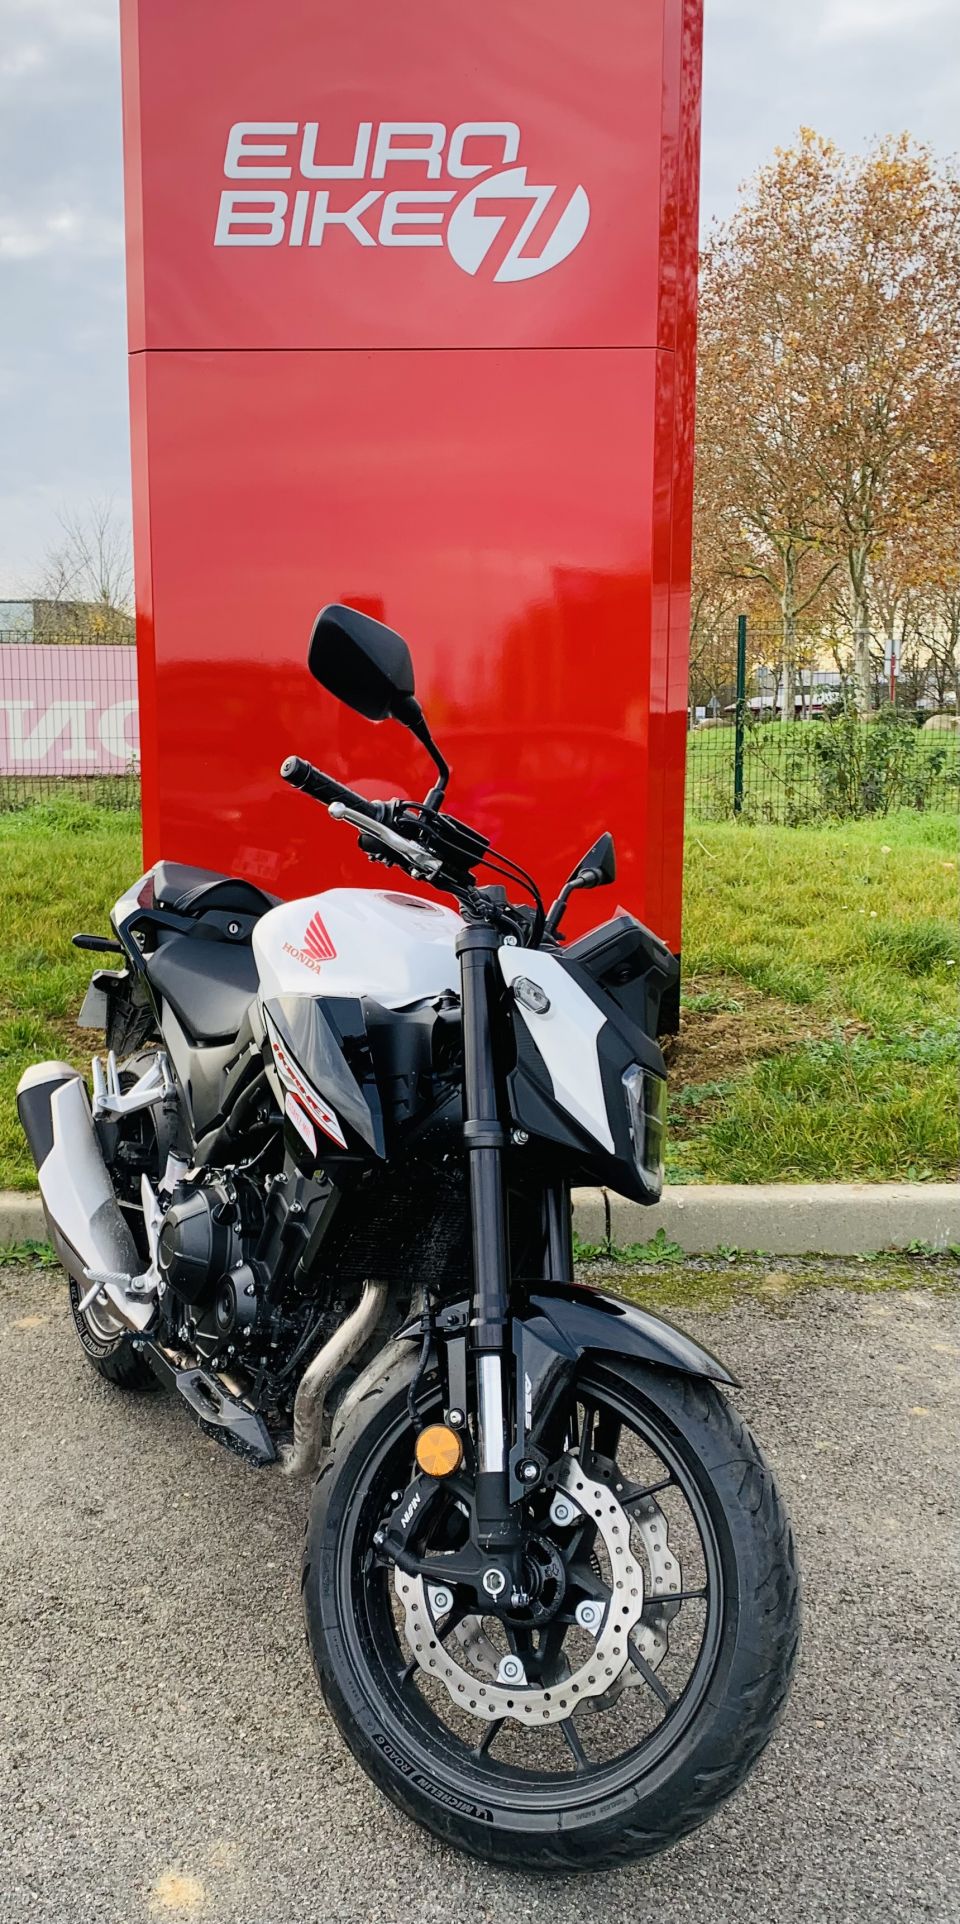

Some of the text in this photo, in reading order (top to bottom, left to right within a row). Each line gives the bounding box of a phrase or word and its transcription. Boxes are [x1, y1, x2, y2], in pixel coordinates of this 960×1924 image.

[223, 121, 520, 179] EURO
[214, 190, 458, 247] BIKE
[282, 942, 321, 975] HONDA
[375, 1735, 475, 1814] MICHELIN ROAD 6
